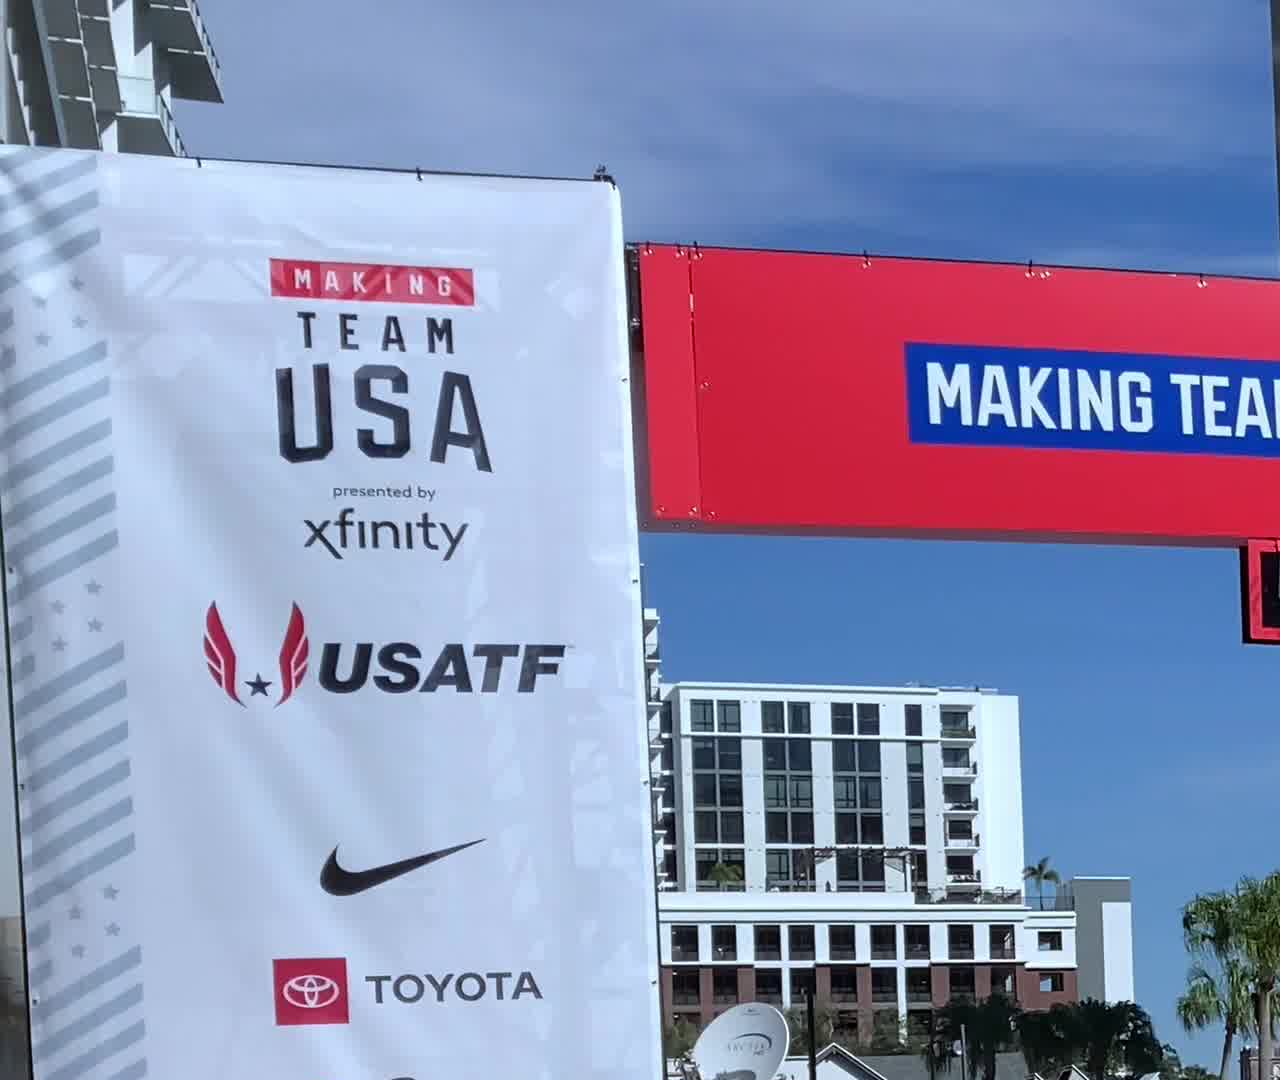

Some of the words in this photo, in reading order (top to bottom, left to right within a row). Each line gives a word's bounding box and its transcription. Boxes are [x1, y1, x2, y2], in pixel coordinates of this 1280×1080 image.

[294, 267, 451, 297] MAKING
[297, 311, 454, 354] TEAM
[275, 362, 493, 474] USA
[926, 361, 1154, 435] MAKING
[333, 486, 412, 499] presented
[417, 485, 436, 502] by
[303, 507, 470, 561] xfinity
[318, 642, 566, 694] USATF
[364, 970, 543, 1004] TOYOTA
